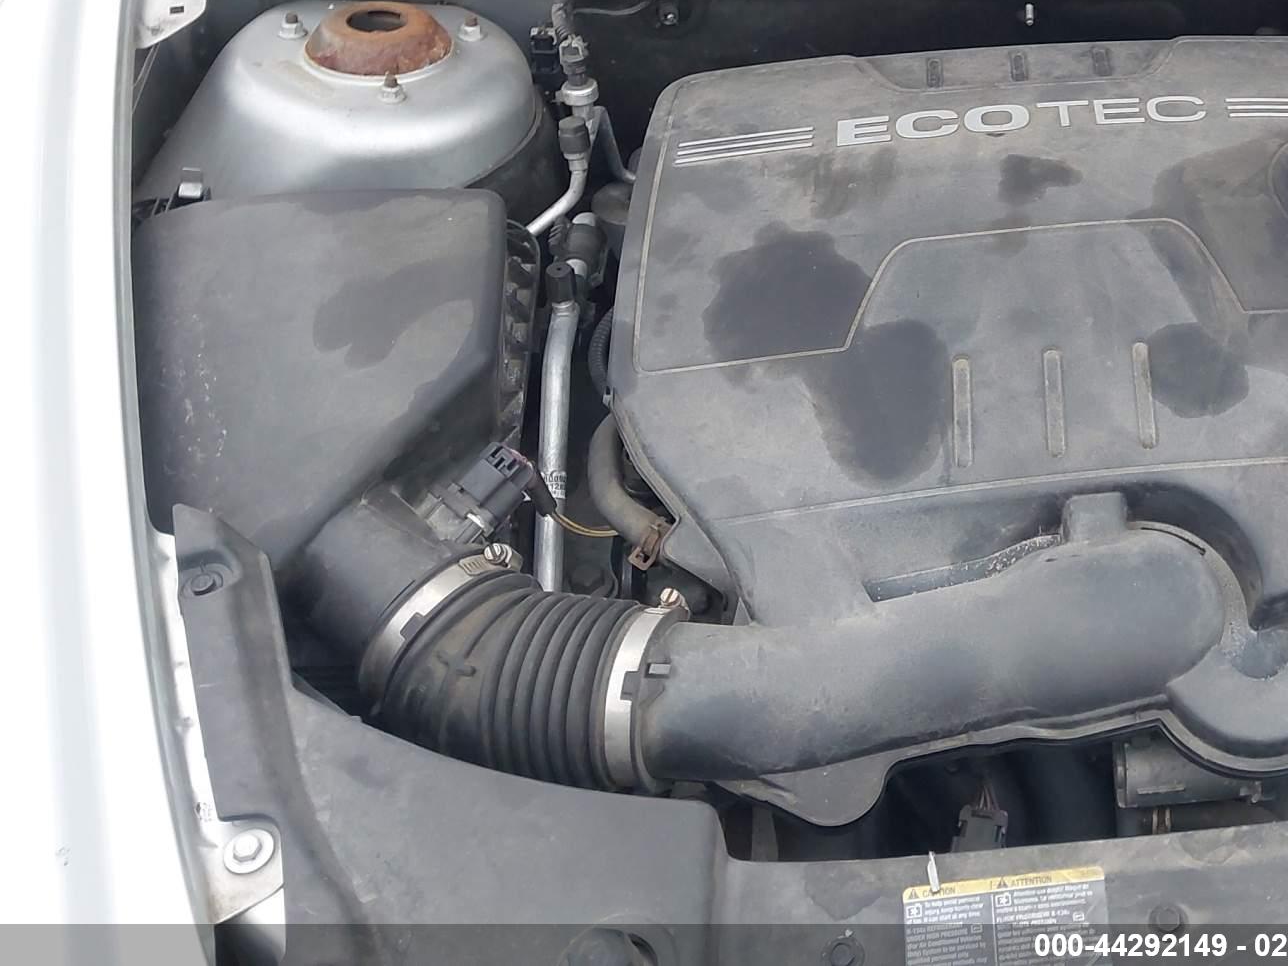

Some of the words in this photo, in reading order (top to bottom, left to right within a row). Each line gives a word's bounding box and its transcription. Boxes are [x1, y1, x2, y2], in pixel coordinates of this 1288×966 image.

[836, 95, 1207, 147] ECOTEC
[1010, 876, 1052, 887] ATTENTION
[922, 887, 956, 899] CATION
